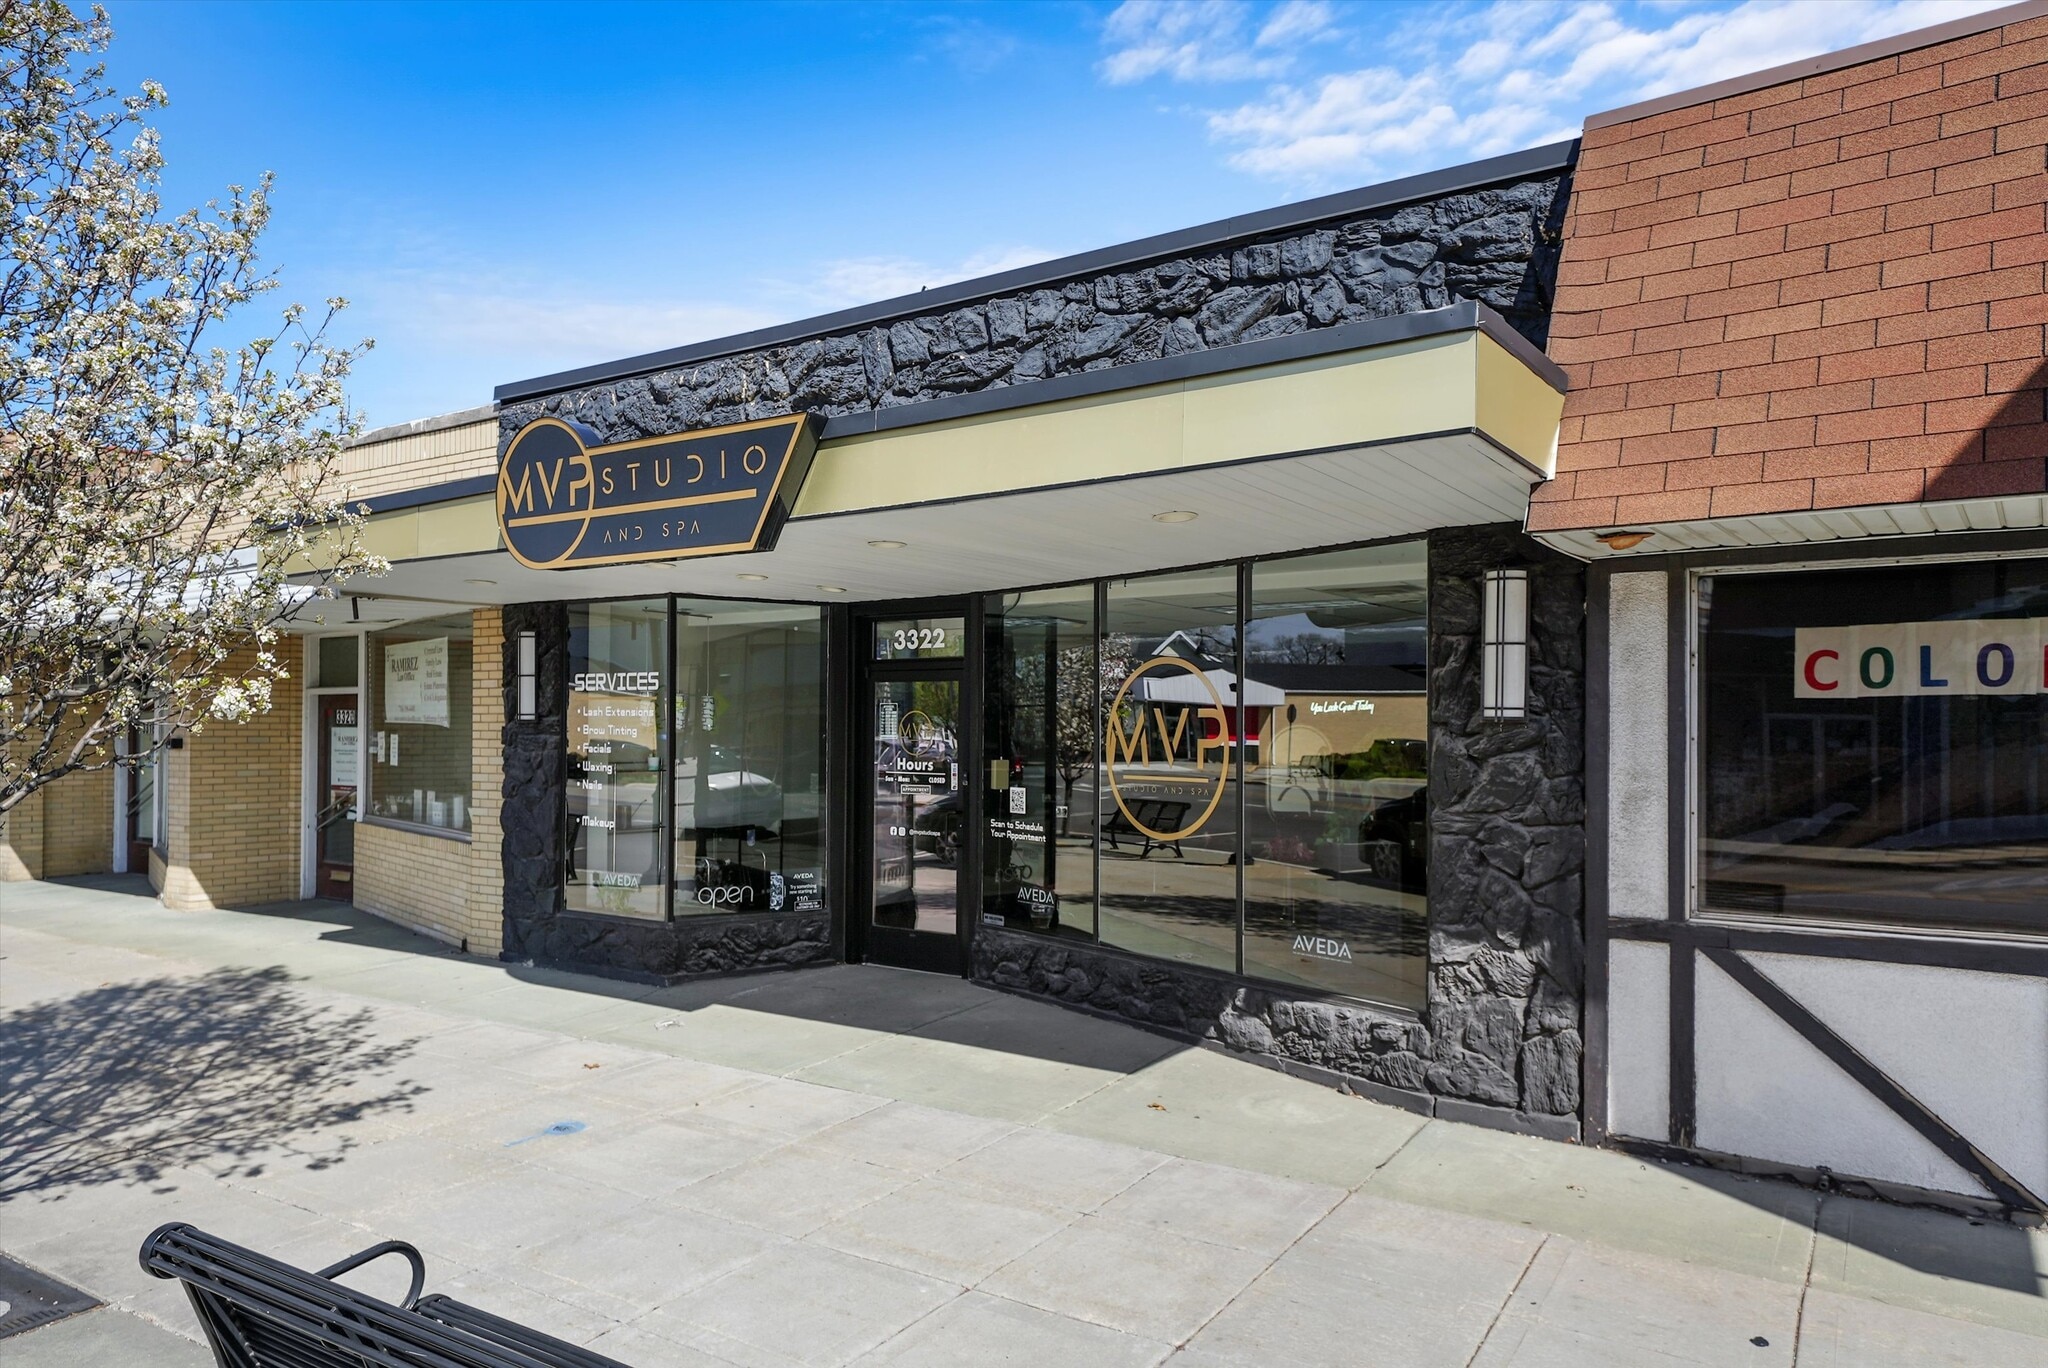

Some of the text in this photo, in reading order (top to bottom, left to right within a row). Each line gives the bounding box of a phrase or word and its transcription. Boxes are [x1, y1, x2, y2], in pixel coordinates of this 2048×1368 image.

[601, 445, 767, 495] STUDIO
[502, 455, 592, 514] MVP
[603, 519, 701, 544] AND SPA
[894, 628, 945, 650] 3322
[391, 656, 419, 673] RAMIREZ
[1803, 642, 2048, 691] COLO
[574, 672, 659, 691] SERVICES
[582, 706, 654, 717] Lash Extensions
[1310, 702, 1323, 715] You
[1323, 701, 1338, 713] Look
[582, 725, 638, 738] Brow Tinting
[1109, 707, 1226, 769] MVP
[582, 743, 612, 753] Facials
[582, 761, 613, 775] Waxing
[897, 757, 934, 771] Hours
[582, 779, 603, 790] Nails
[1163, 786, 1184, 795] AND
[1191, 787, 1209, 796] SPA
[581, 815, 615, 829] Makeup
[990, 819, 1044, 832] Scan to Schedule
[990, 829, 1047, 842] Your Appointment
[603, 872, 639, 888] AVEDA
[793, 872, 814, 880] AVEDA
[698, 885, 754, 909] open
[1017, 886, 1055, 905] AVEDA
[1292, 934, 1352, 959] AVEDA
